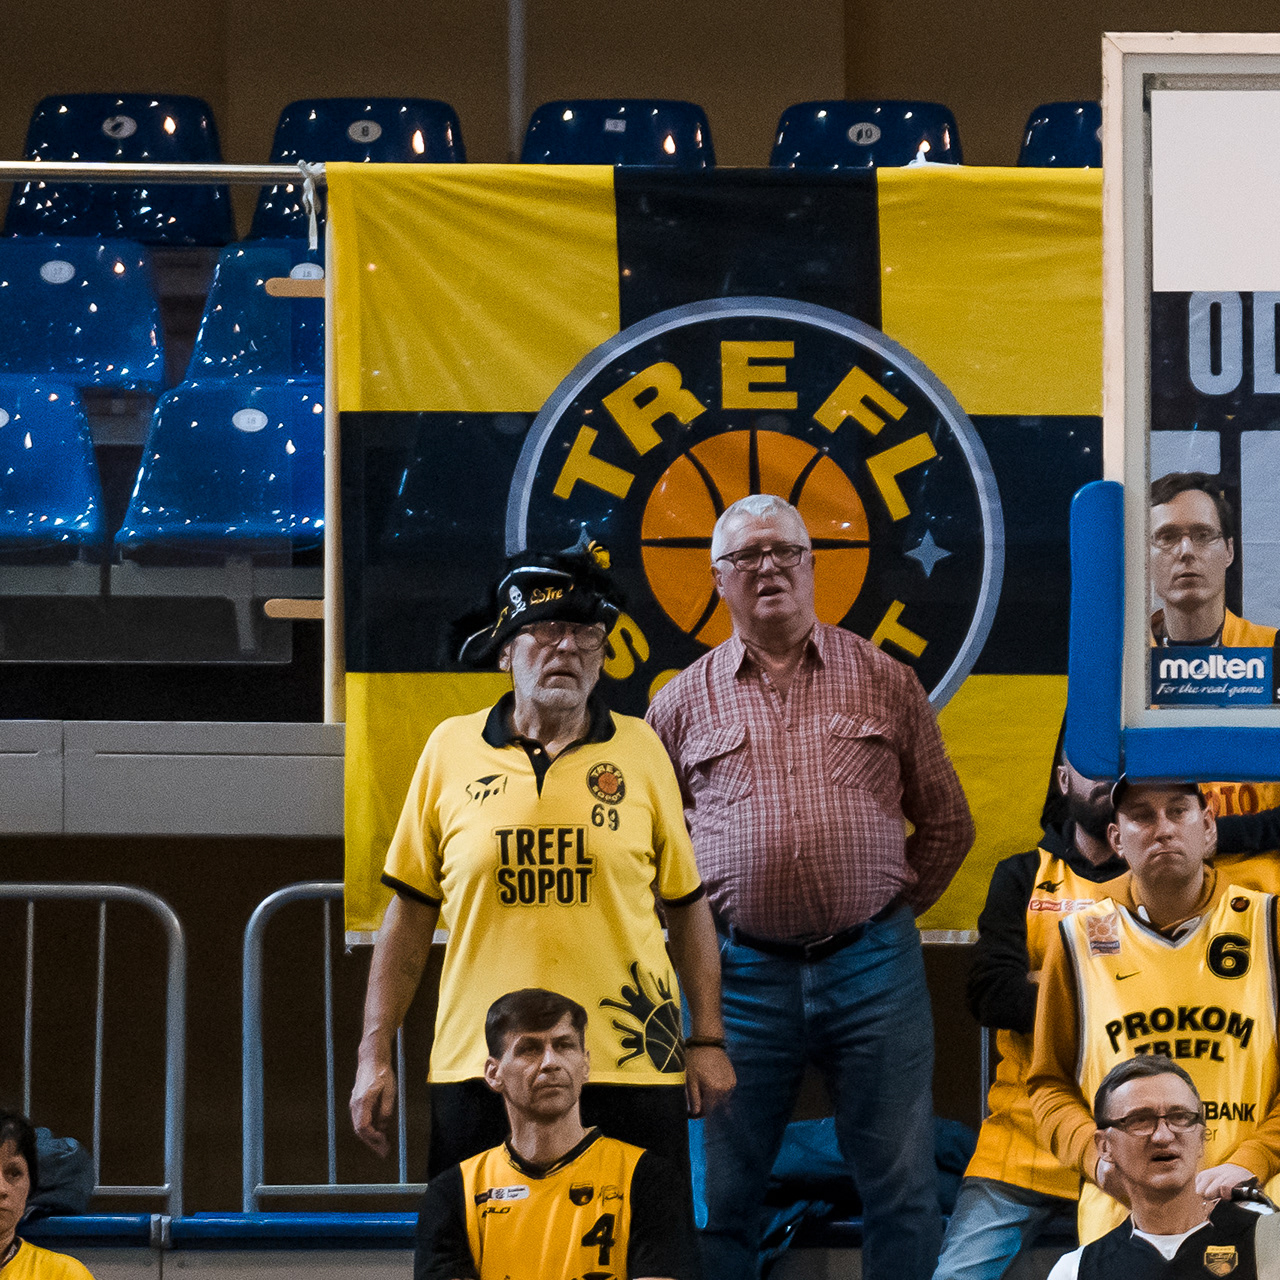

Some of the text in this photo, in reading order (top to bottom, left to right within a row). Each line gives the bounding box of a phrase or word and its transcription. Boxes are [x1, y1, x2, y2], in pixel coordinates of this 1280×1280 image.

[552, 341, 938, 521] TREFL
[1159, 654, 1265, 680] molten
[1178, 683, 1202, 694] the
[1227, 685, 1264, 697] game
[591, 803, 620, 831] 69
[495, 827, 593, 866] TREFL
[498, 867, 593, 904] SOPOT
[1206, 932, 1252, 980] 6
[1105, 1006, 1255, 1054] PROKOM
[1134, 1038, 1226, 1063] TREFL
[1206, 1100, 1255, 1122] BANK
[581, 1212, 616, 1266] 4
